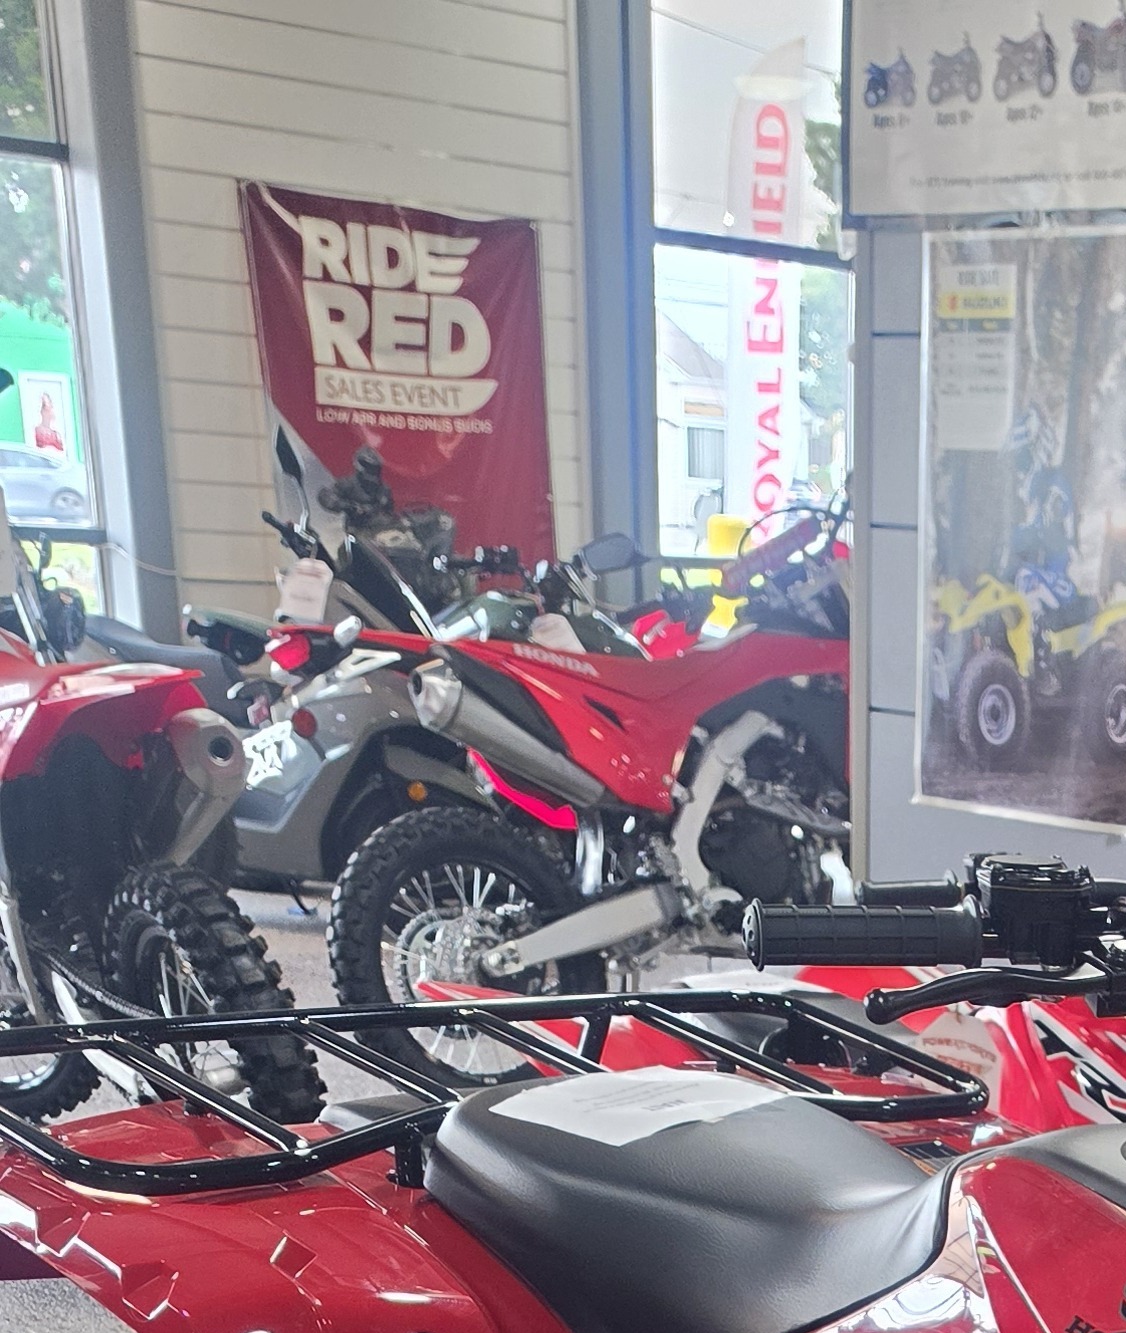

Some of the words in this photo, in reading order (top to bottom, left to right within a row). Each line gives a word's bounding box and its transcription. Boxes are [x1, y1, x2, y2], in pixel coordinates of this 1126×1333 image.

[299, 214, 481, 295] RIDE
[747, 103, 791, 355] ENIELD
[303, 279, 491, 378] RED
[323, 374, 387, 405] SALES
[389, 381, 465, 410] EVENT
[377, 412, 406, 430] AND
[752, 367, 783, 539] OYAL
[513, 643, 600, 679] HONDA
